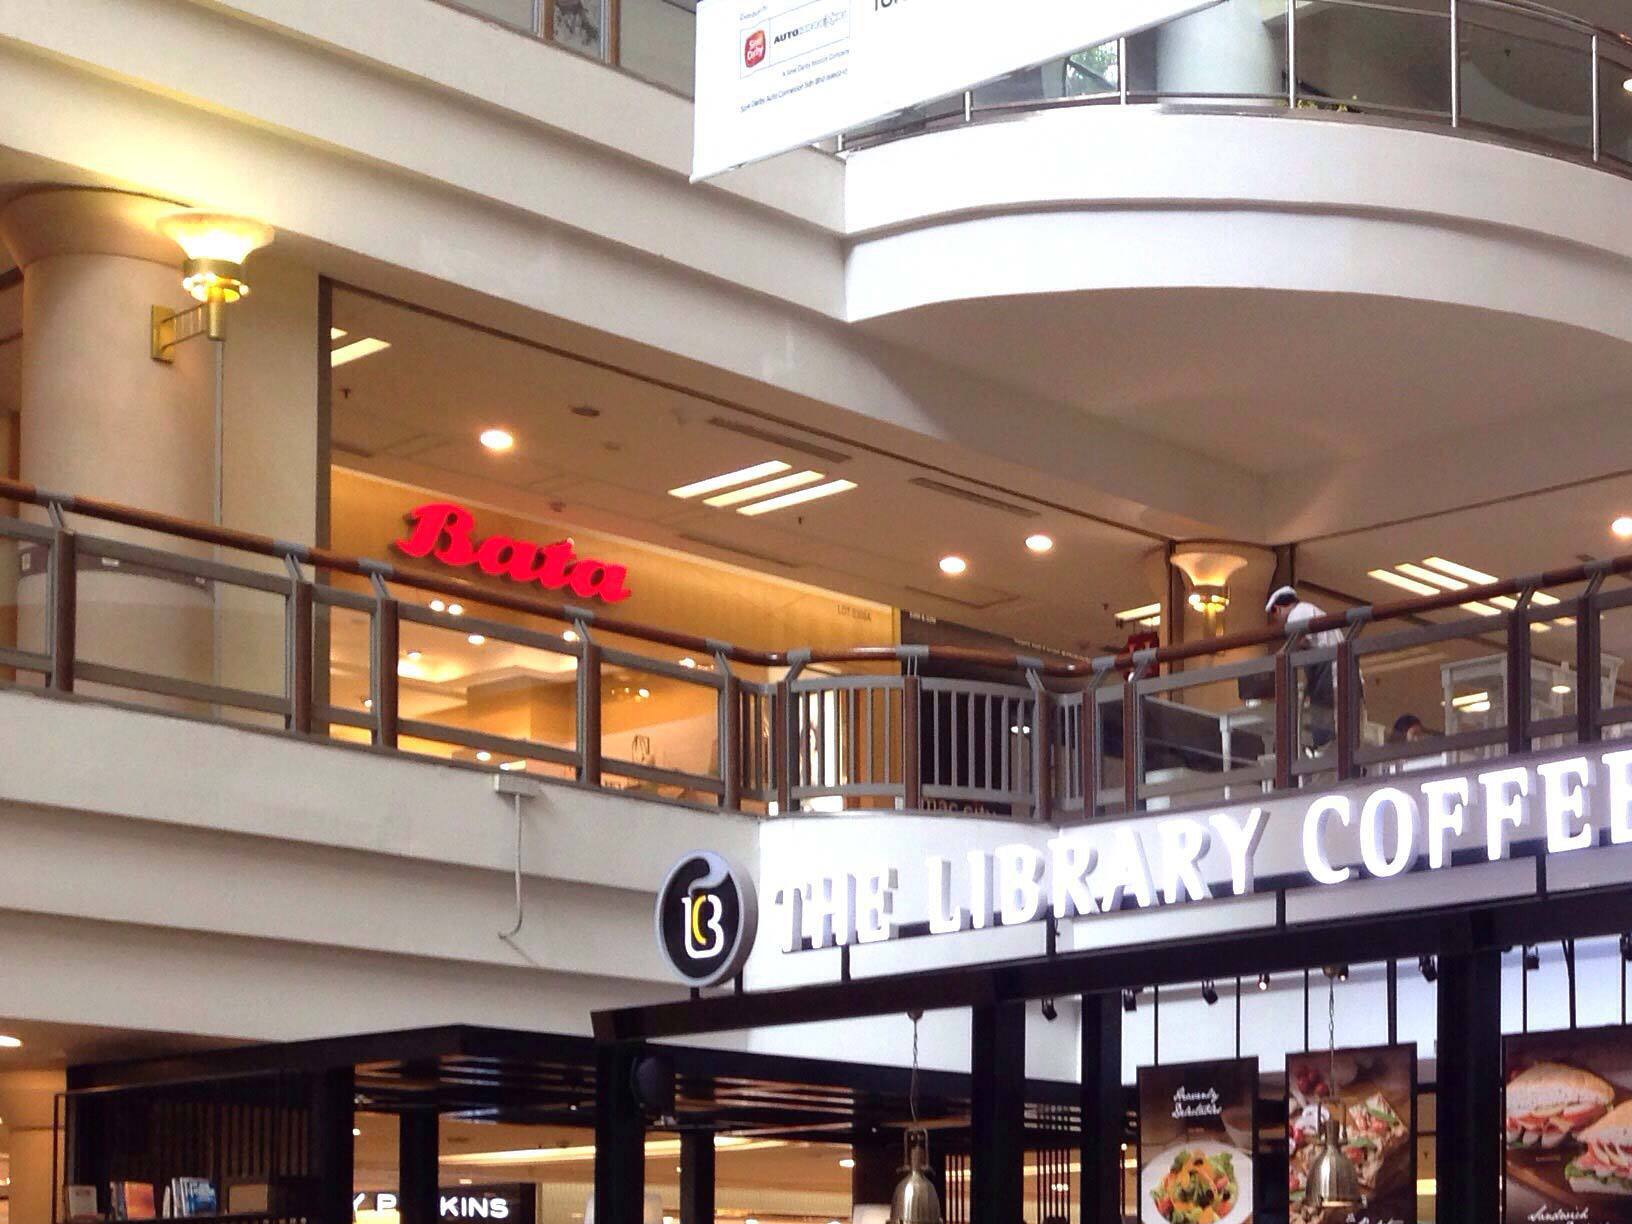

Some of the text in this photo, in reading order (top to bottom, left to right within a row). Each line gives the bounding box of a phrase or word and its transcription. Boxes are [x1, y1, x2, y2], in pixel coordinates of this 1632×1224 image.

[395, 502, 632, 604] Bata
[775, 866, 898, 954] THE
[924, 807, 1268, 935] LIBRARY
